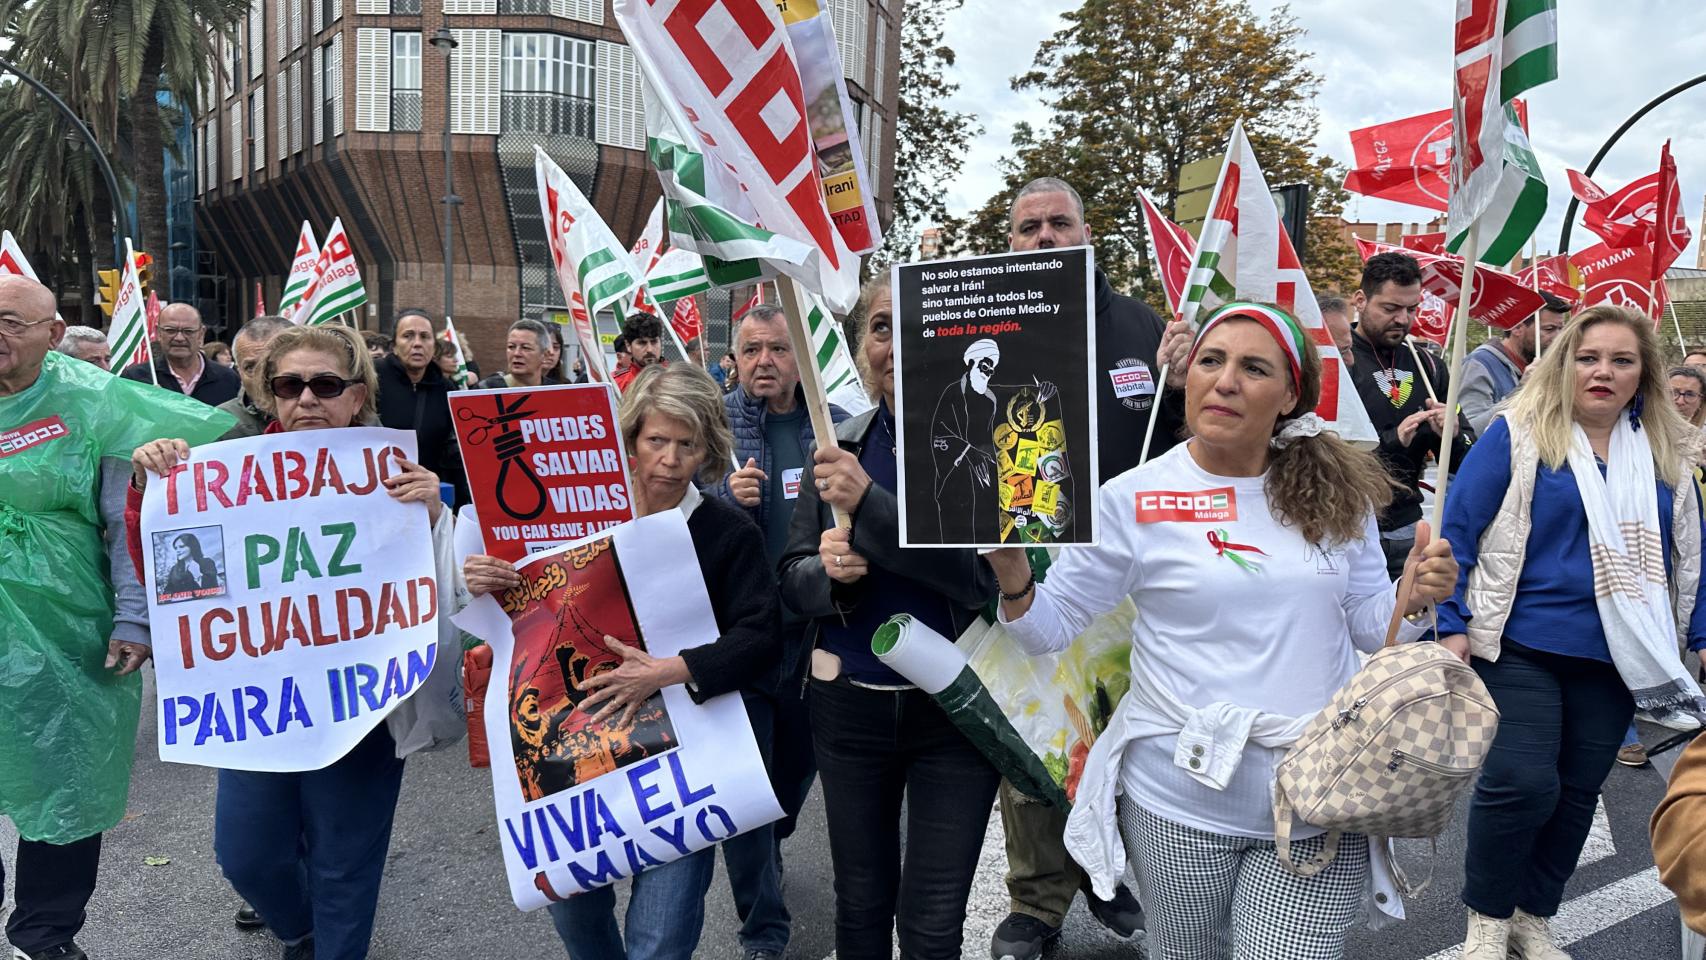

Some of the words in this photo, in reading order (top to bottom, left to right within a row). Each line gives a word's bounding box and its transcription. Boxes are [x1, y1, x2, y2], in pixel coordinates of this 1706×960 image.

[825, 176, 854, 197] Irani
[921, 271, 936, 281] No
[938, 268, 959, 280] solo
[960, 265, 1004, 278] estamos
[1005, 258, 1063, 273] intentando
[921, 283, 951, 295] salvar
[953, 284, 960, 292] a
[961, 280, 985, 292] Irán!
[922, 297, 943, 308] sino
[944, 293, 986, 307] también
[987, 295, 994, 303] a
[996, 291, 1026, 303] todos
[1027, 289, 1044, 300] los
[922, 309, 962, 324] pueblos
[963, 308, 977, 318] de
[978, 305, 1017, 318] Oriente
[1018, 302, 1051, 314] Medio
[1053, 302, 1060, 315] y
[922, 328, 936, 338] de
[936, 323, 963, 337] toda
[966, 322, 977, 335] la
[979, 319, 1022, 336] región.
[1115, 373, 1141, 384] CCOO
[14, 423, 65, 450] CCOO
[519, 415, 607, 443] PUEDES
[532, 448, 620, 477] SALVAR
[160, 446, 407, 515] TRABAJO
[548, 483, 628, 513] VIDAS
[1141, 495, 1211, 511] CCOO
[1194, 511, 1230, 520] Málaga
[492, 524, 520, 541] YOU
[521, 523, 549, 540] CAN
[550, 521, 585, 539] SAVE
[586, 520, 596, 535] A
[244, 522, 362, 590] PAZ
[178, 576, 438, 669] IGUALDAD
[163, 676, 313, 746] PARA
[327, 643, 438, 722] IRAN
[504, 788, 626, 870] VIVA
[626, 751, 716, 825] EL
[567, 804, 738, 891] MAYO
